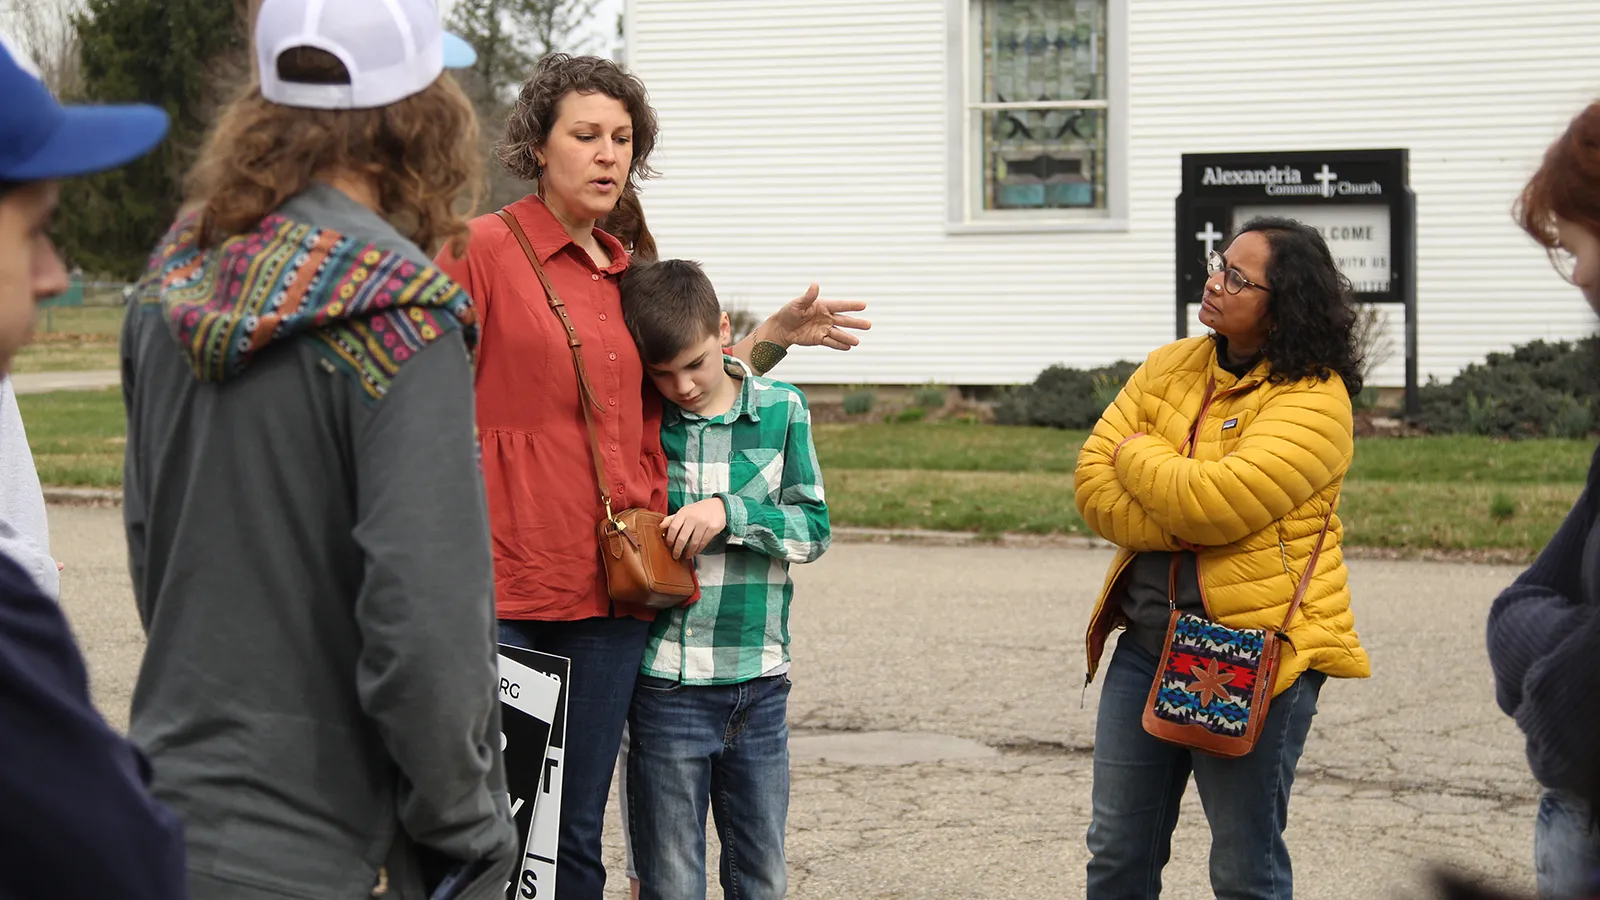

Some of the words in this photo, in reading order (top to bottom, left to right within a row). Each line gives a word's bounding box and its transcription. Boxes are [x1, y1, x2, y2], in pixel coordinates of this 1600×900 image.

[1202, 166, 1302, 185] Alexandria
[1337, 181, 1382, 195] Church
[1319, 226, 1374, 241] LCOME
[1372, 256, 1387, 268] US
